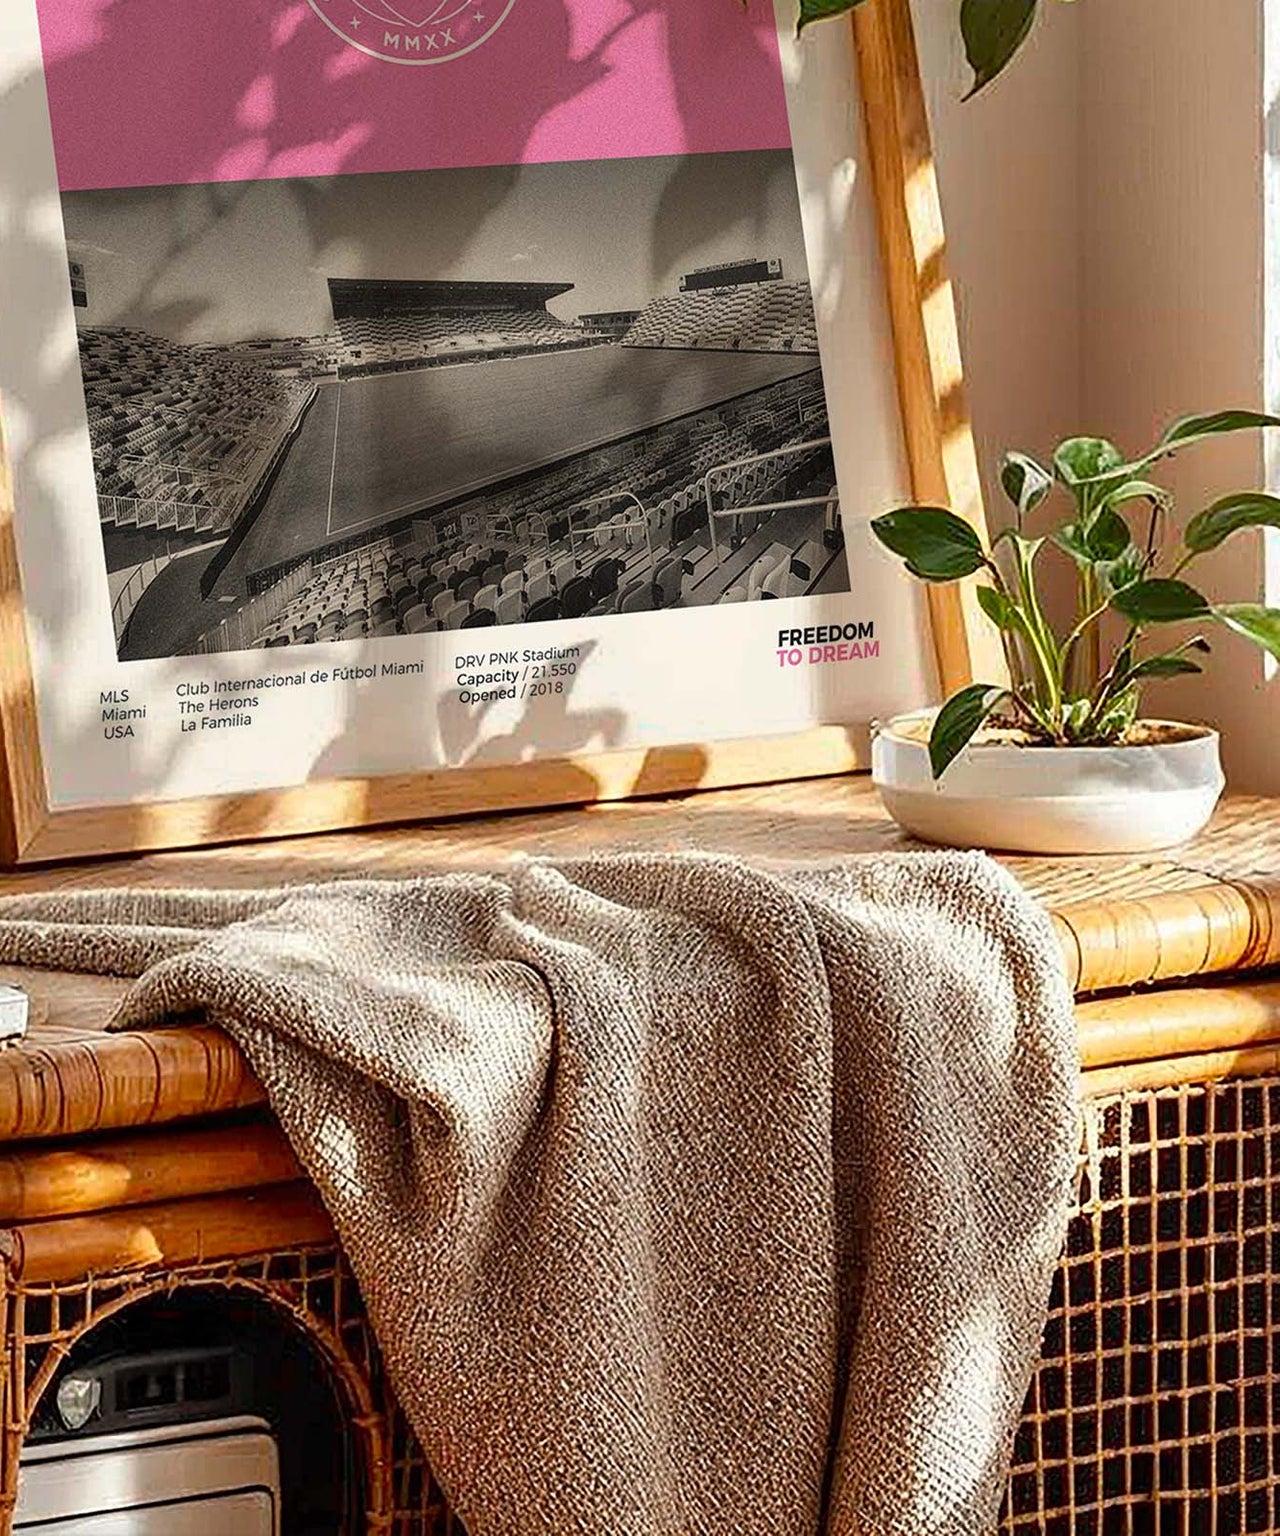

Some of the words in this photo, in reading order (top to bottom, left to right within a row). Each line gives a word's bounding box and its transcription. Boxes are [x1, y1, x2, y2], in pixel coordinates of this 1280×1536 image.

[383, 28, 457, 52] MMXX
[778, 621, 874, 647] FREEDOM
[455, 654, 486, 669] DRV
[489, 651, 519, 666] PNK
[522, 645, 580, 663] Stadium
[776, 649, 803, 667] TO
[809, 641, 880, 664] DREAM
[175, 681, 210, 697] Club
[214, 671, 306, 694] Internacional
[309, 669, 329, 684] de
[332, 664, 377, 682] Fútbol
[381, 659, 424, 677] Miami
[457, 669, 519, 686] Capacity
[100, 689, 129, 704] MLS
[459, 686, 516, 705] Opened
[530, 682, 563, 696] 2018
[102, 705, 146, 722] Miami
[178, 700, 205, 714] The
[209, 696, 259, 712] Herons
[104, 725, 135, 740] USA
[181, 720, 196, 732] La
[201, 713, 252, 730] Familia
